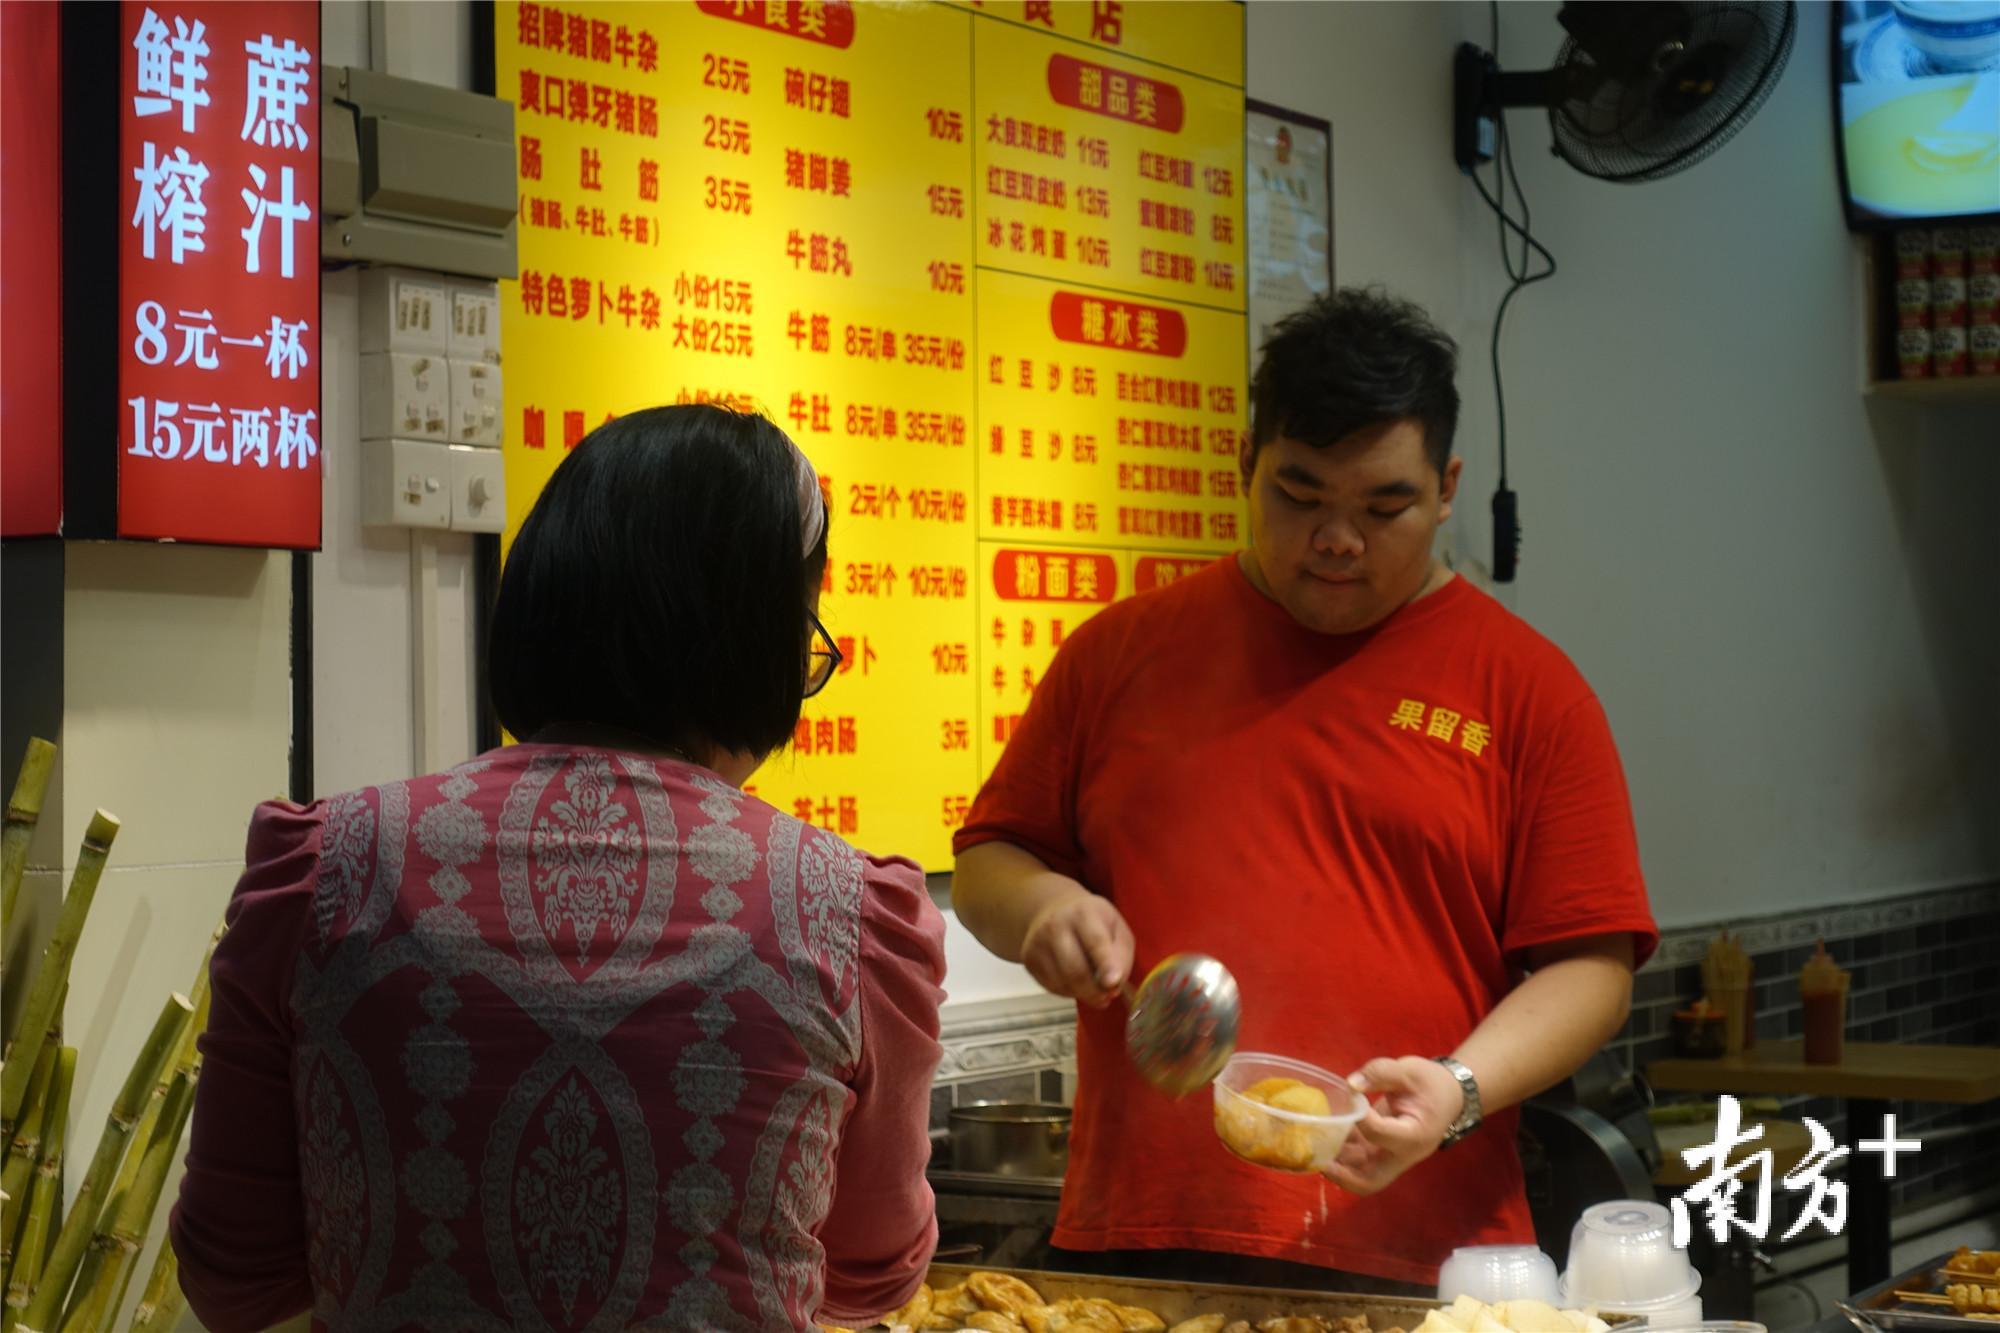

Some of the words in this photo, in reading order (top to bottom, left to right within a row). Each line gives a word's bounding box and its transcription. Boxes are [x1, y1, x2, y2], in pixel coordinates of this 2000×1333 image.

[518, 2, 658, 73] 招牌猪肠牛杂
[704, 53, 750, 94] 25元
[519, 69, 658, 138] 爽口弹牙猪肠
[704, 115, 750, 155] 25元
[785, 67, 850, 118] 碗仔翅
[927, 109, 962, 143] 10元
[1079, 66, 1157, 124] 甜品类
[133, 8, 211, 264] 鲜榨
[240, 34, 312, 278] 蔗汁
[705, 176, 751, 215] 35元
[786, 149, 850, 196] 猪脚姜
[928, 186, 962, 218] 15元
[787, 232, 852, 276] 牛筋丸
[928, 262, 964, 294] 10元
[521, 270, 660, 329] 特色萝卜牛杂
[675, 273, 752, 314] 小份15元
[1081, 299, 1159, 351] 糖水类
[135, 302, 307, 378] 8元一杯
[672, 315, 753, 357] 大份25元
[788, 313, 830, 352] 牛筋
[128, 397, 316, 468] 15元两杯
[523, 403, 622, 450] 咖喱
[789, 394, 831, 432] 牛肚
[850, 484, 900, 515] 2元/个
[848, 564, 895, 594] 3元/个
[1015, 554, 1097, 599] 粉面类
[933, 644, 966, 672] 10元
[941, 719, 968, 750] 3元
[1389, 699, 1492, 757] 果留香
